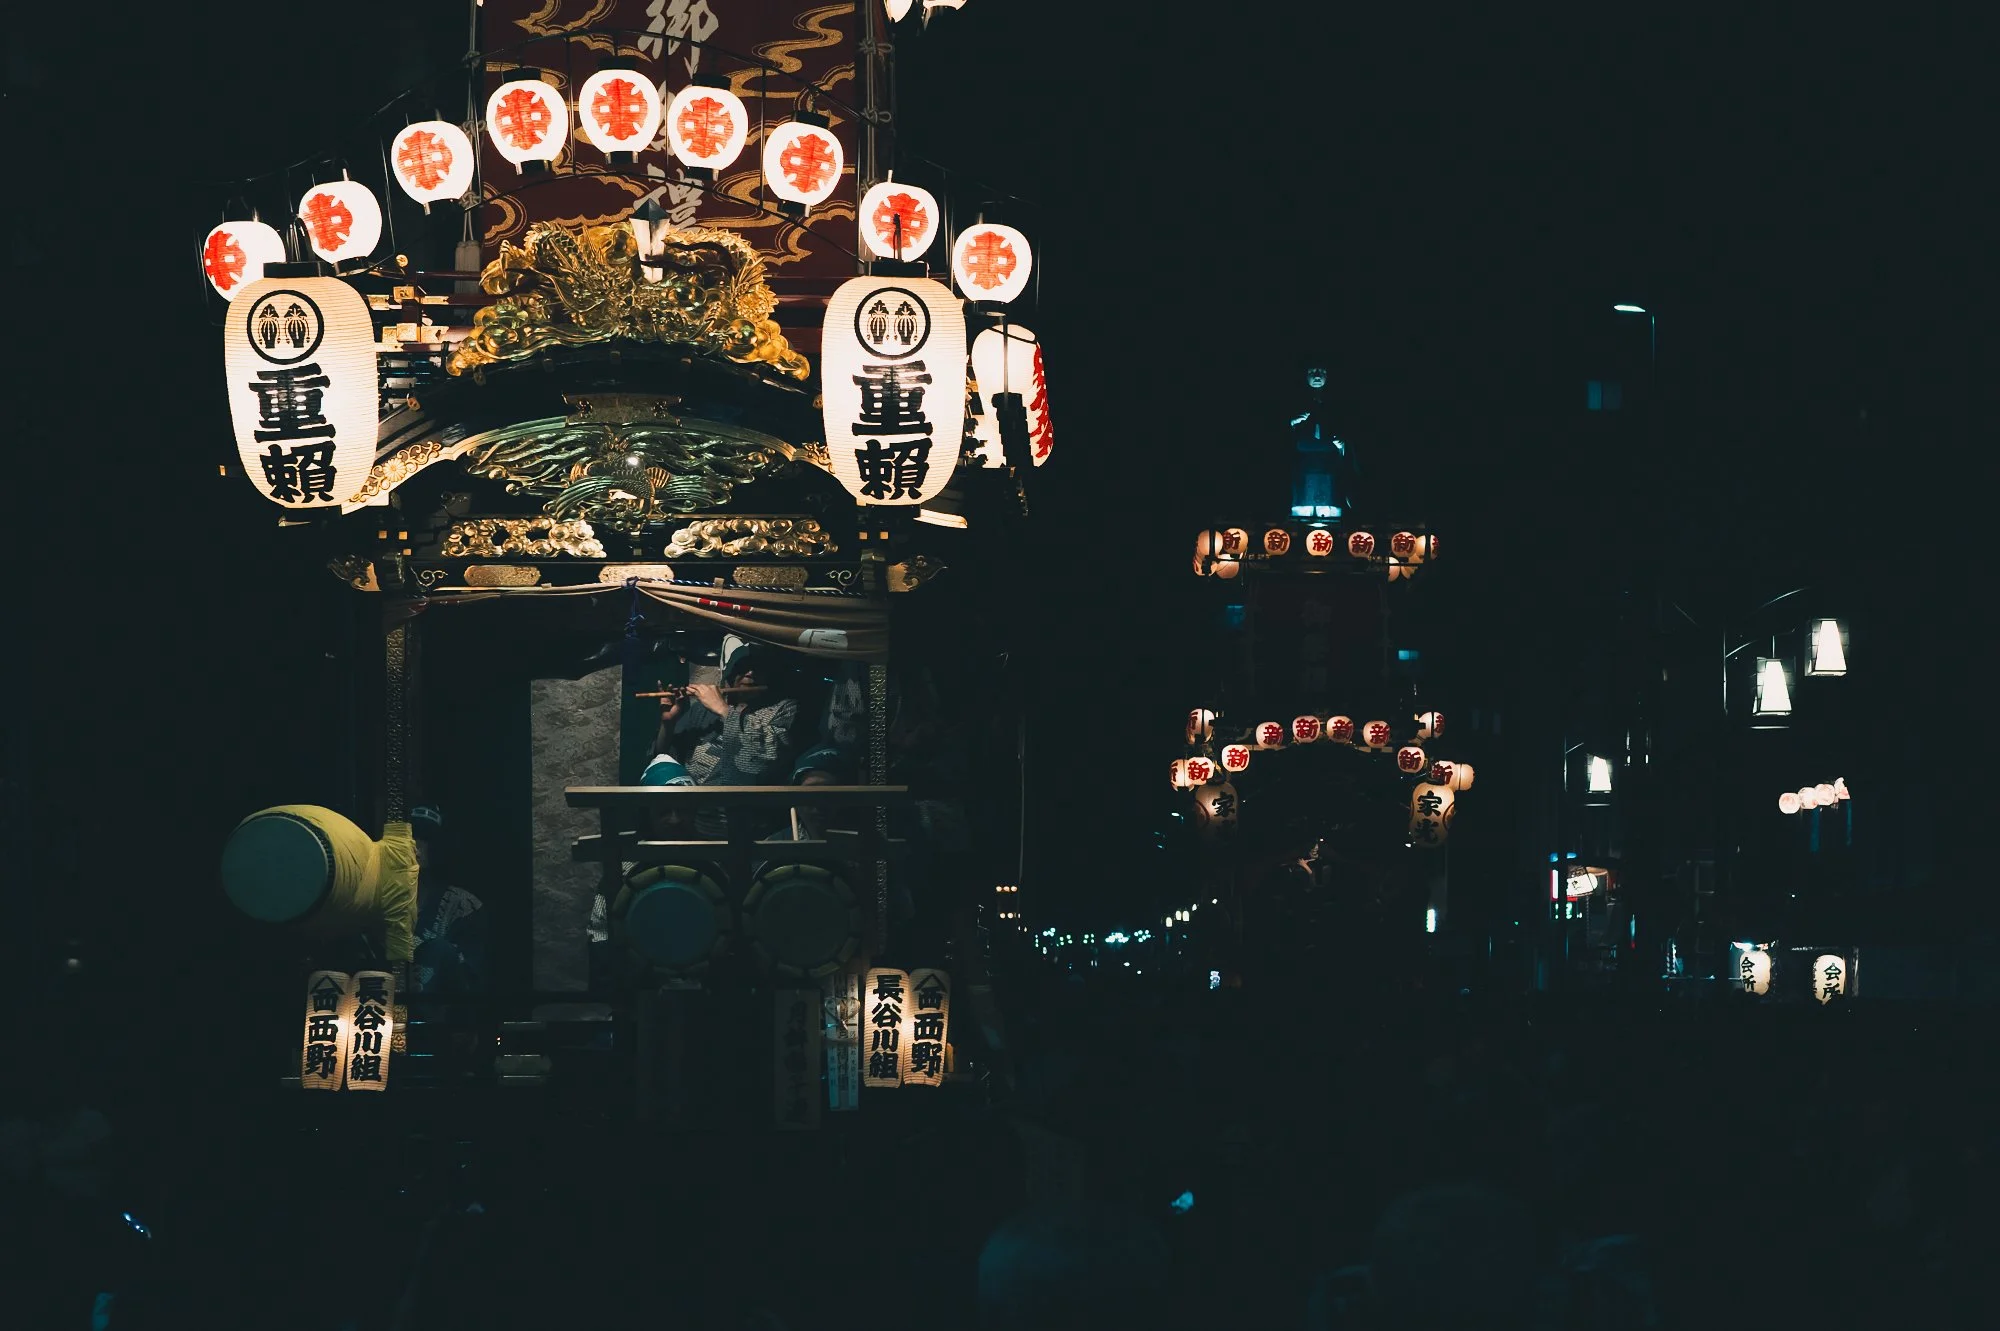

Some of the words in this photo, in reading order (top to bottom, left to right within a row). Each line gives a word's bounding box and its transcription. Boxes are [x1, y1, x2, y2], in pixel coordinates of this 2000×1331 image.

[1268, 531, 1288, 552] 新
[1313, 532, 1332, 552] 新
[1351, 535, 1373, 554] 新
[1393, 534, 1415, 554] 新
[1263, 725, 1283, 745] 新
[1296, 718, 1319, 739] 新
[1332, 719, 1353, 739] 新
[1370, 724, 1391, 744] 新
[1227, 748, 1249, 768] 新
[1399, 750, 1421, 770] 新
[1188, 761, 1210, 781] 新
[1741, 957, 1756, 991] 会所
[1822, 963, 1842, 999] 会所
[351, 977, 388, 1082] 長谷川組
[869, 975, 904, 1079] 長谷川組
